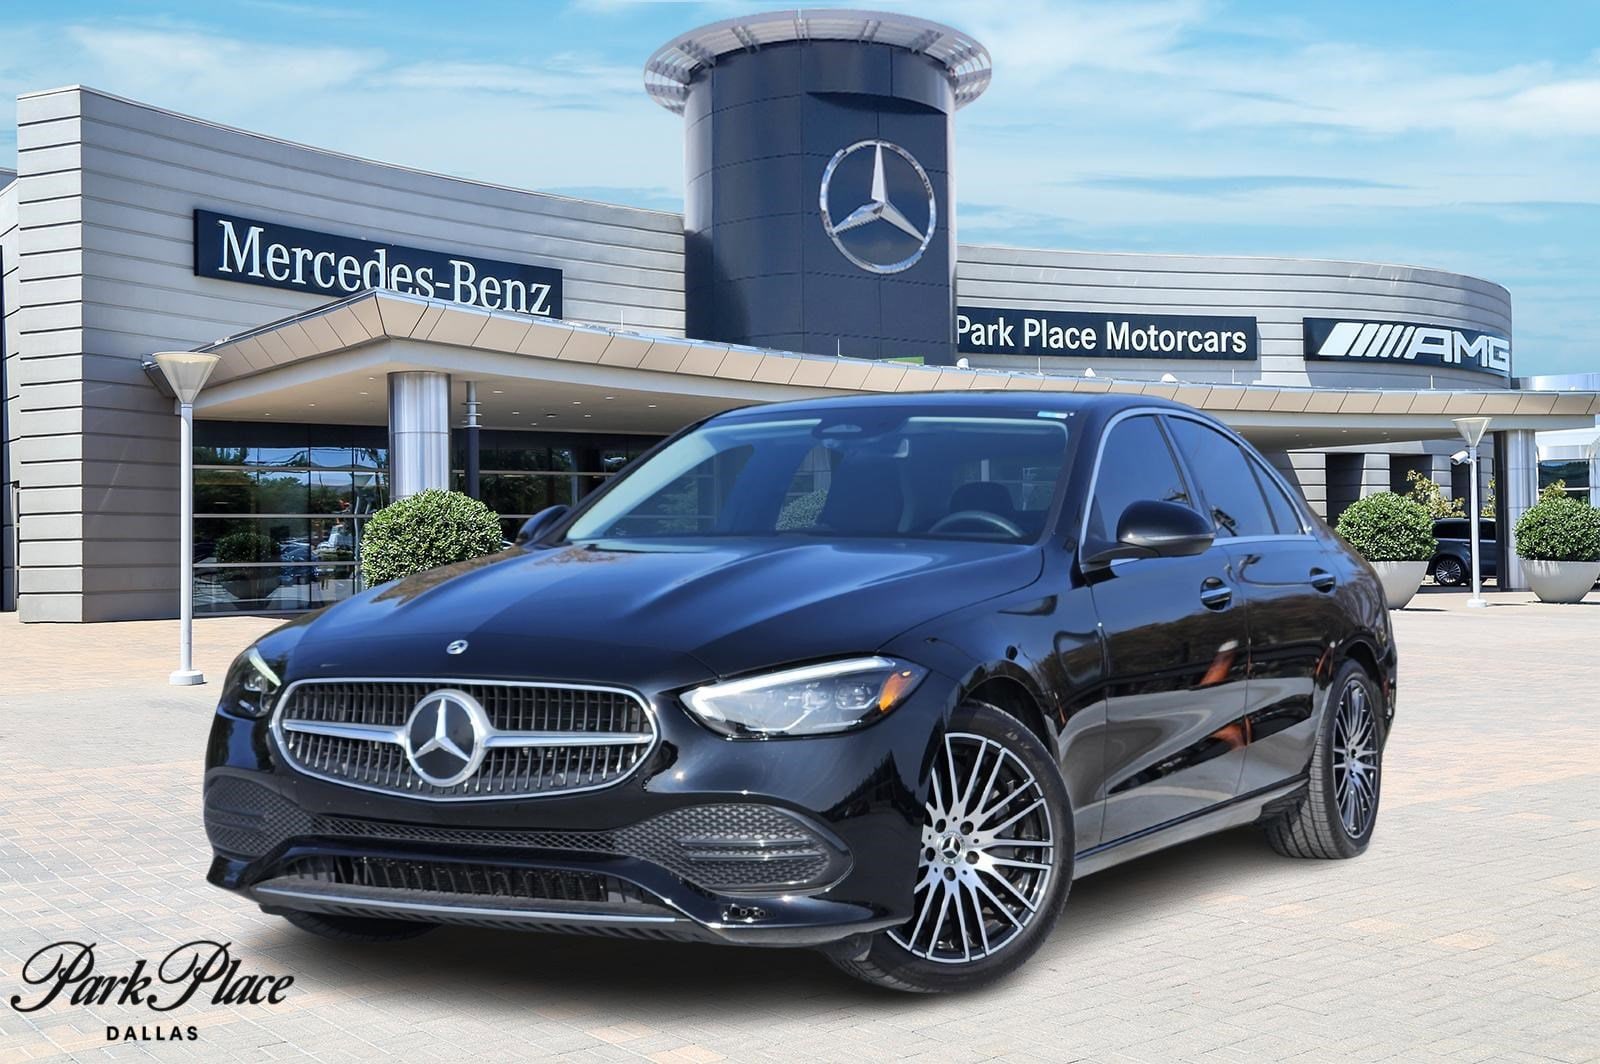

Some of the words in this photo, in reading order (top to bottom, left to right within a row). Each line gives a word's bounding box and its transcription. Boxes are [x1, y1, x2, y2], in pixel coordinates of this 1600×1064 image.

[218, 219, 552, 316] Mercedes-Benz
[957, 315, 1014, 347] Park
[1023, 318, 1097, 350] Place
[1106, 321, 1247, 353] Motorcars
[1404, 327, 1509, 373] AMG
